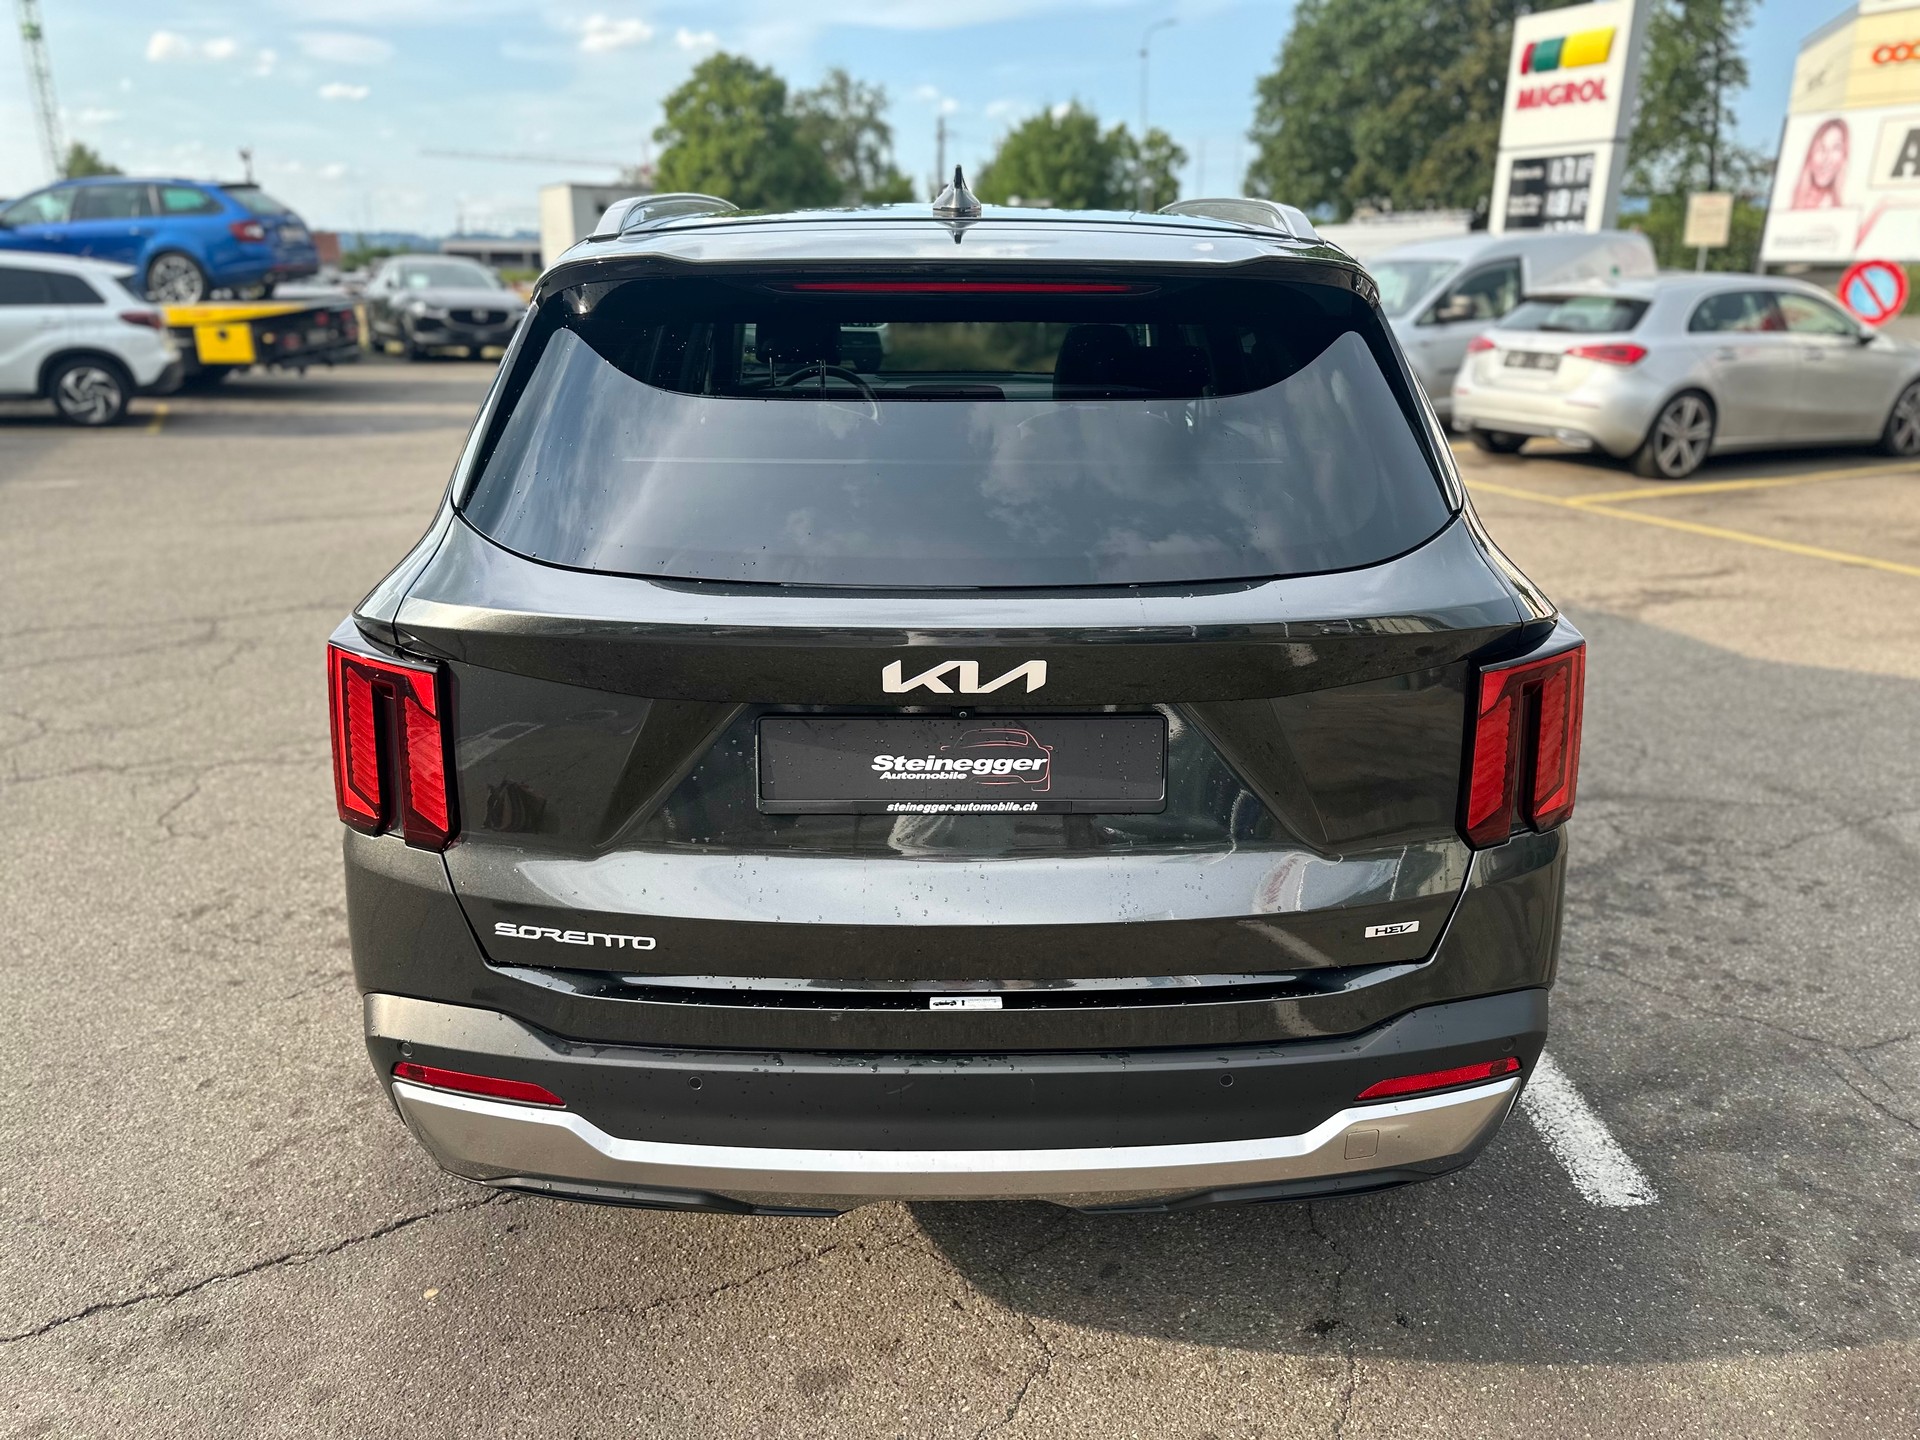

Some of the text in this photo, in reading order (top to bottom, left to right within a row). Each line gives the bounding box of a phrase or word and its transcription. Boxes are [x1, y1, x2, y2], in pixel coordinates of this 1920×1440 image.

[1517, 79, 1606, 110] MIGROL
[882, 660, 1047, 693] KIA
[871, 754, 1048, 775] Steinegger
[879, 771, 968, 780] Automobile
[886, 802, 1038, 814] steinegger-automobile.ch
[494, 922, 657, 950] SORENTO
[1374, 923, 1414, 936] HEV
